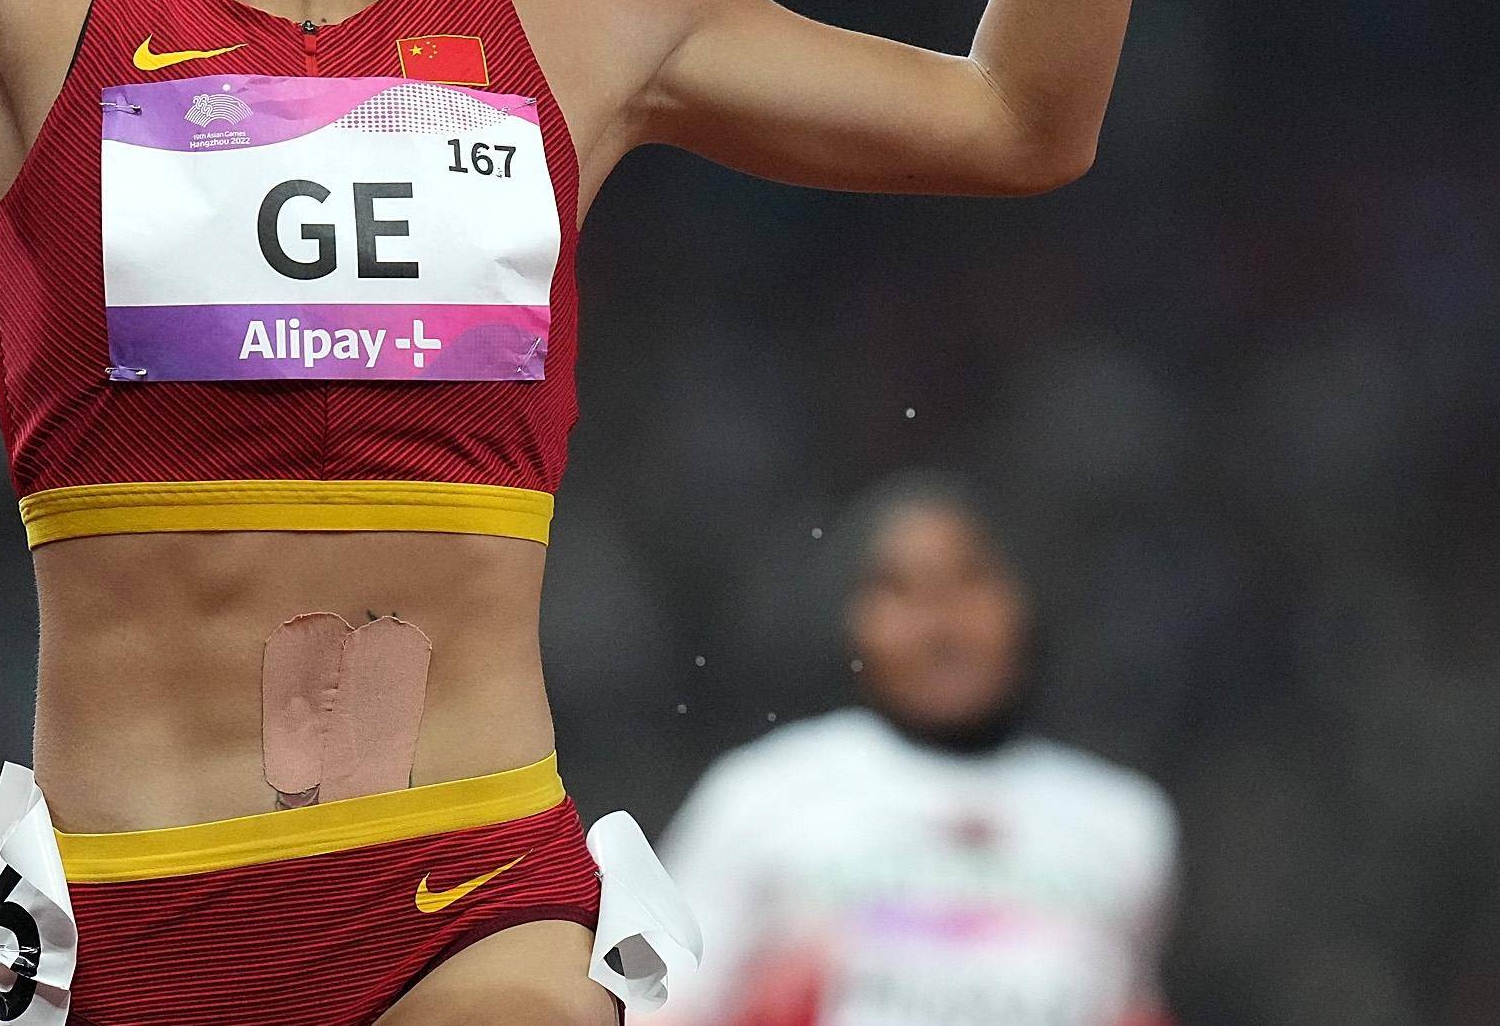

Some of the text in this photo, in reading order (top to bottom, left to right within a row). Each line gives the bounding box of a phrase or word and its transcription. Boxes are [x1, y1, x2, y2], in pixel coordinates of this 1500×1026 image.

[189, 137, 251, 149] Hangzhou 2022
[206, 131, 224, 139] Asian
[447, 138, 517, 179] 167
[257, 179, 420, 281] GE
